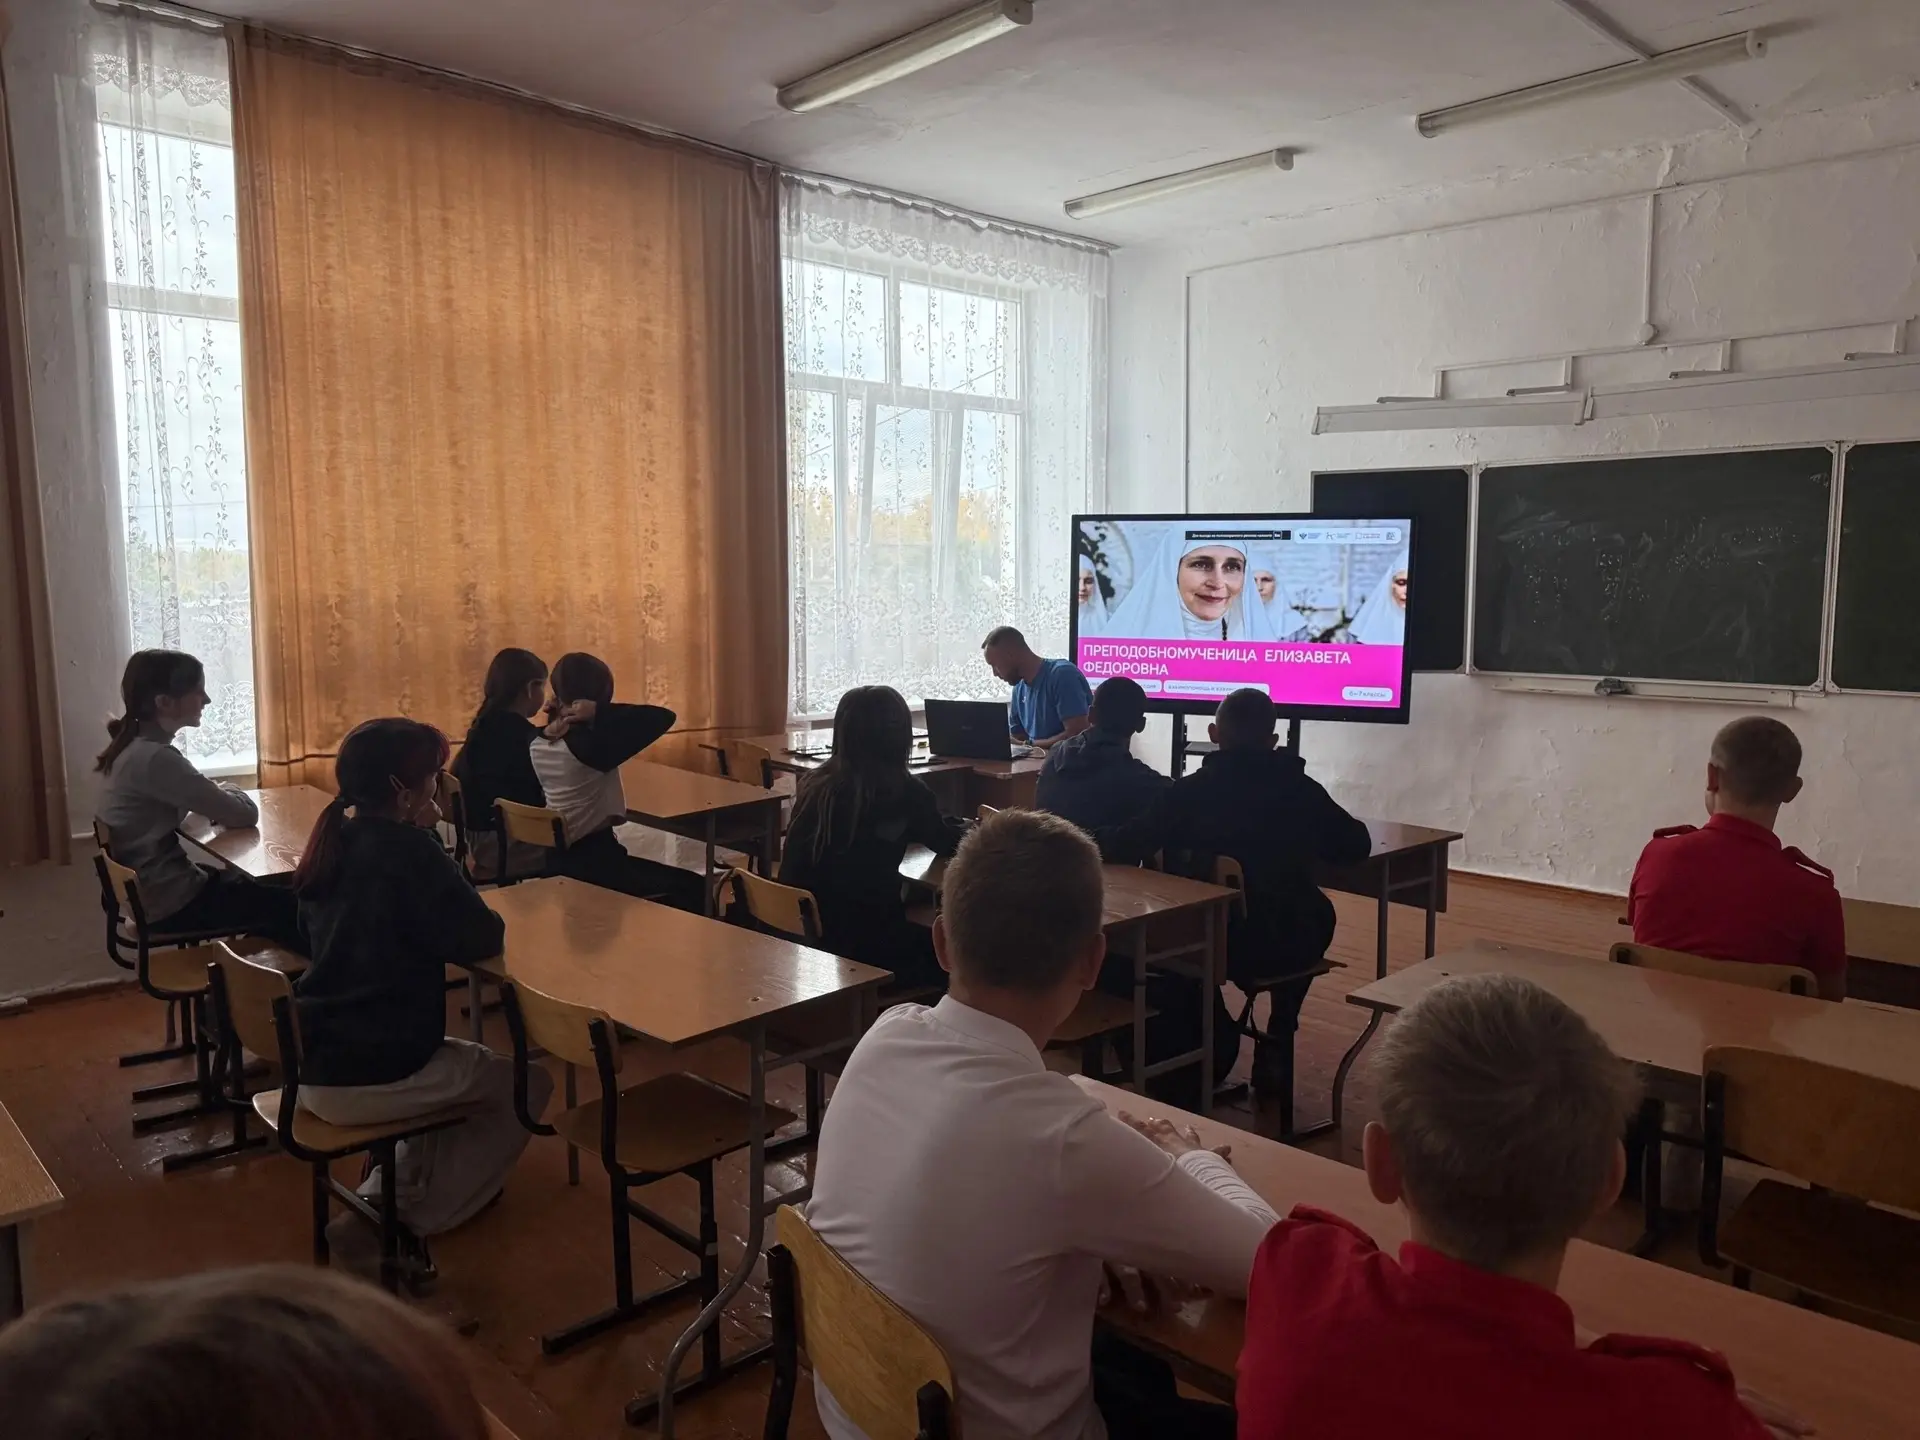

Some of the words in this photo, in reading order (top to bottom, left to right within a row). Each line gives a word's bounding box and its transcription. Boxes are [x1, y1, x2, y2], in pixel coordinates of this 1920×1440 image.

[1083, 644, 1257, 663] ПРЕПОДОБНОМУЧЕНИЦА
[1264, 649, 1352, 665] ЕЛИЗАВЕТА
[1083, 661, 1169, 675] ФЕДОРОВНА
